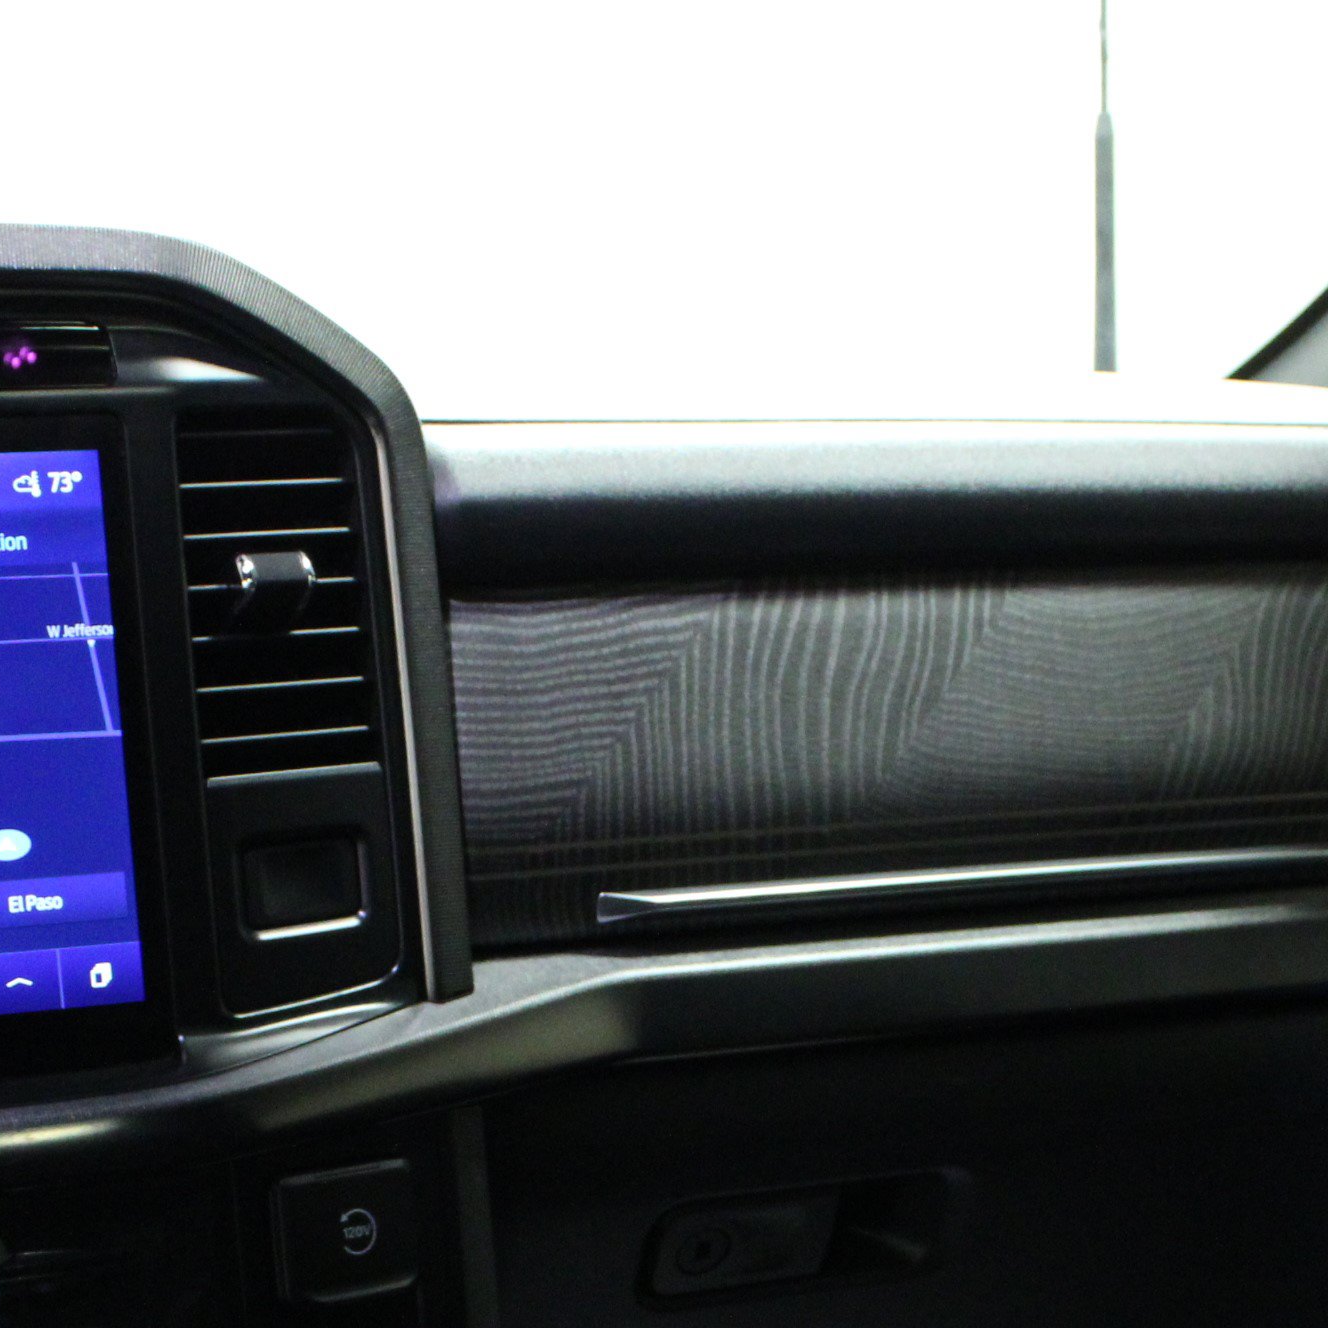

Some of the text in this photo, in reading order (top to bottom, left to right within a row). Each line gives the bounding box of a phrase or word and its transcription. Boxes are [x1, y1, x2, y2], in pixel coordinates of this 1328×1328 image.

[47, 471, 83, 494] 73°
[46, 624, 61, 639] W
[8, 895, 63, 914] El Paso
